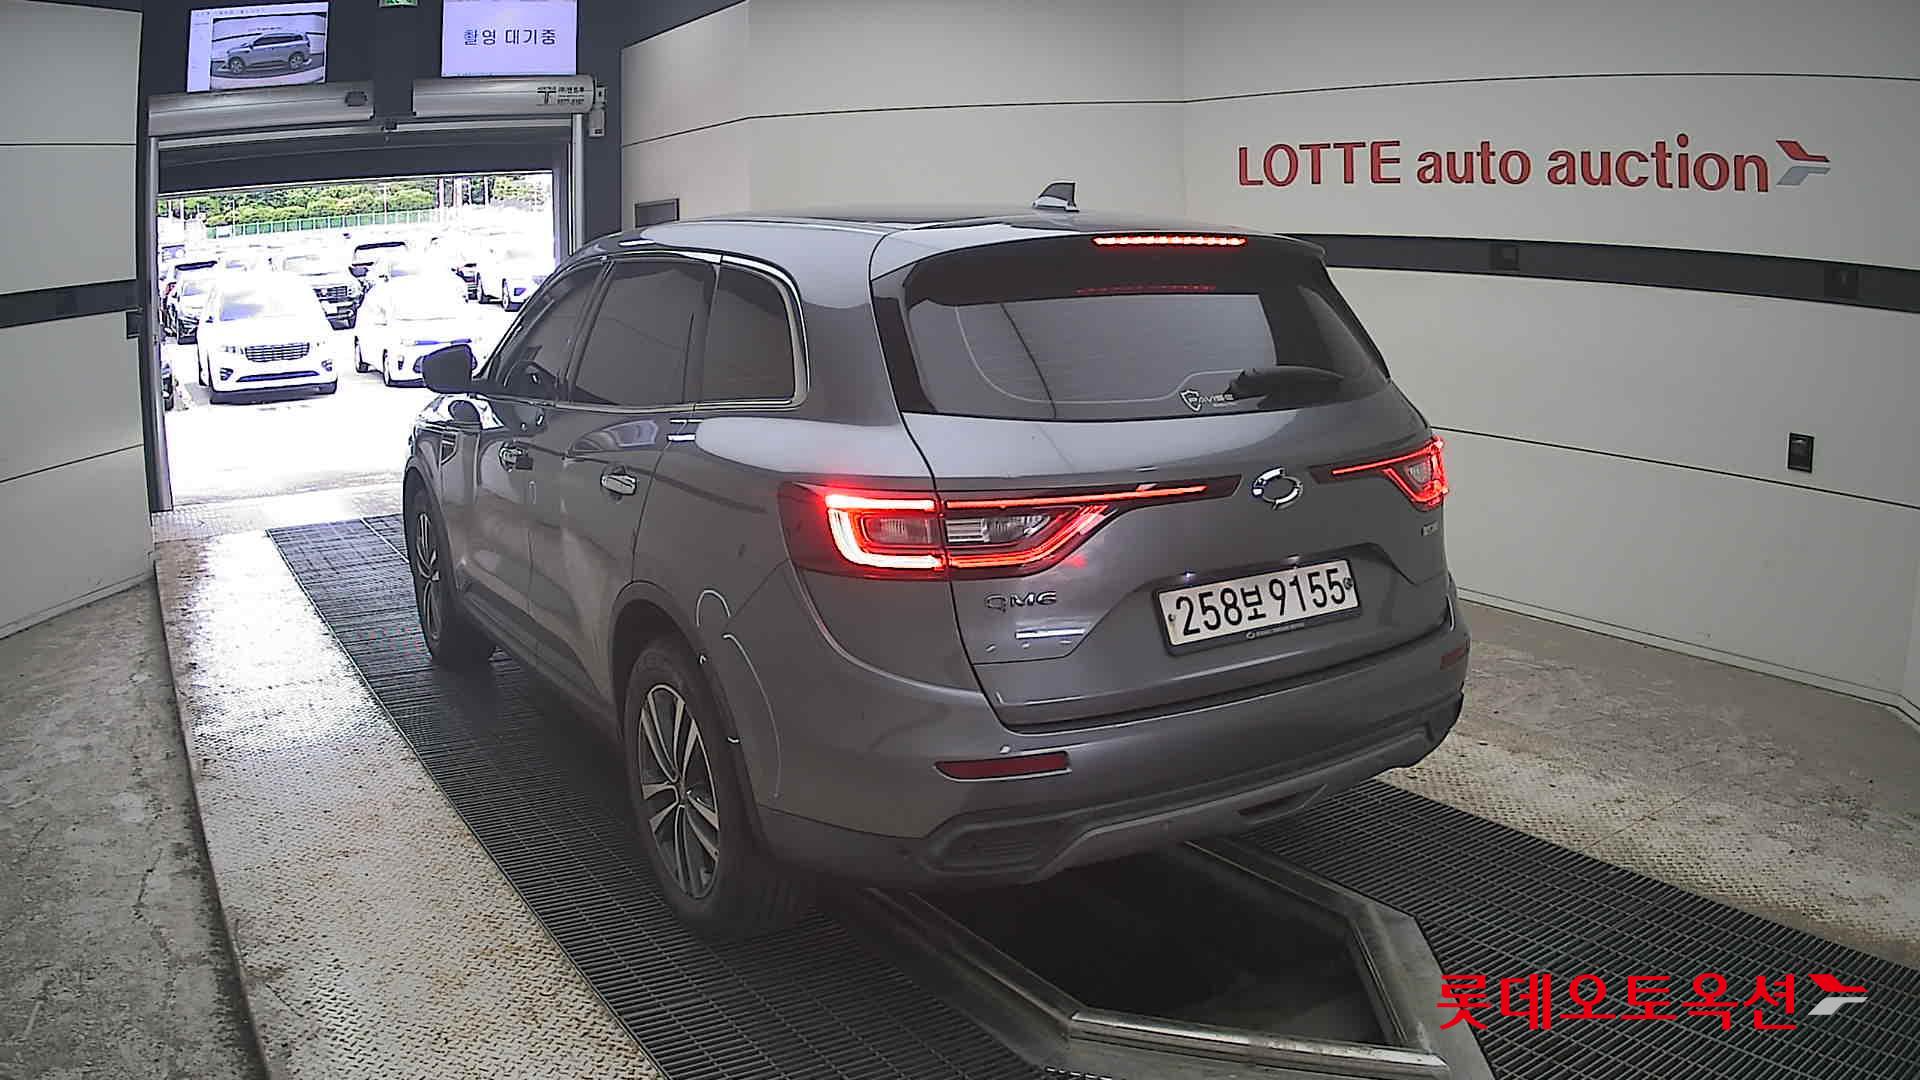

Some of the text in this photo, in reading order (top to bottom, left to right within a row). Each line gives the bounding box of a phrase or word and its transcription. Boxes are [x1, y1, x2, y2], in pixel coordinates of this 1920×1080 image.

[504, 29, 556, 45] 대기중
[1238, 133, 1769, 192] LOTTE auto auction
[984, 591, 1057, 613] QM6
